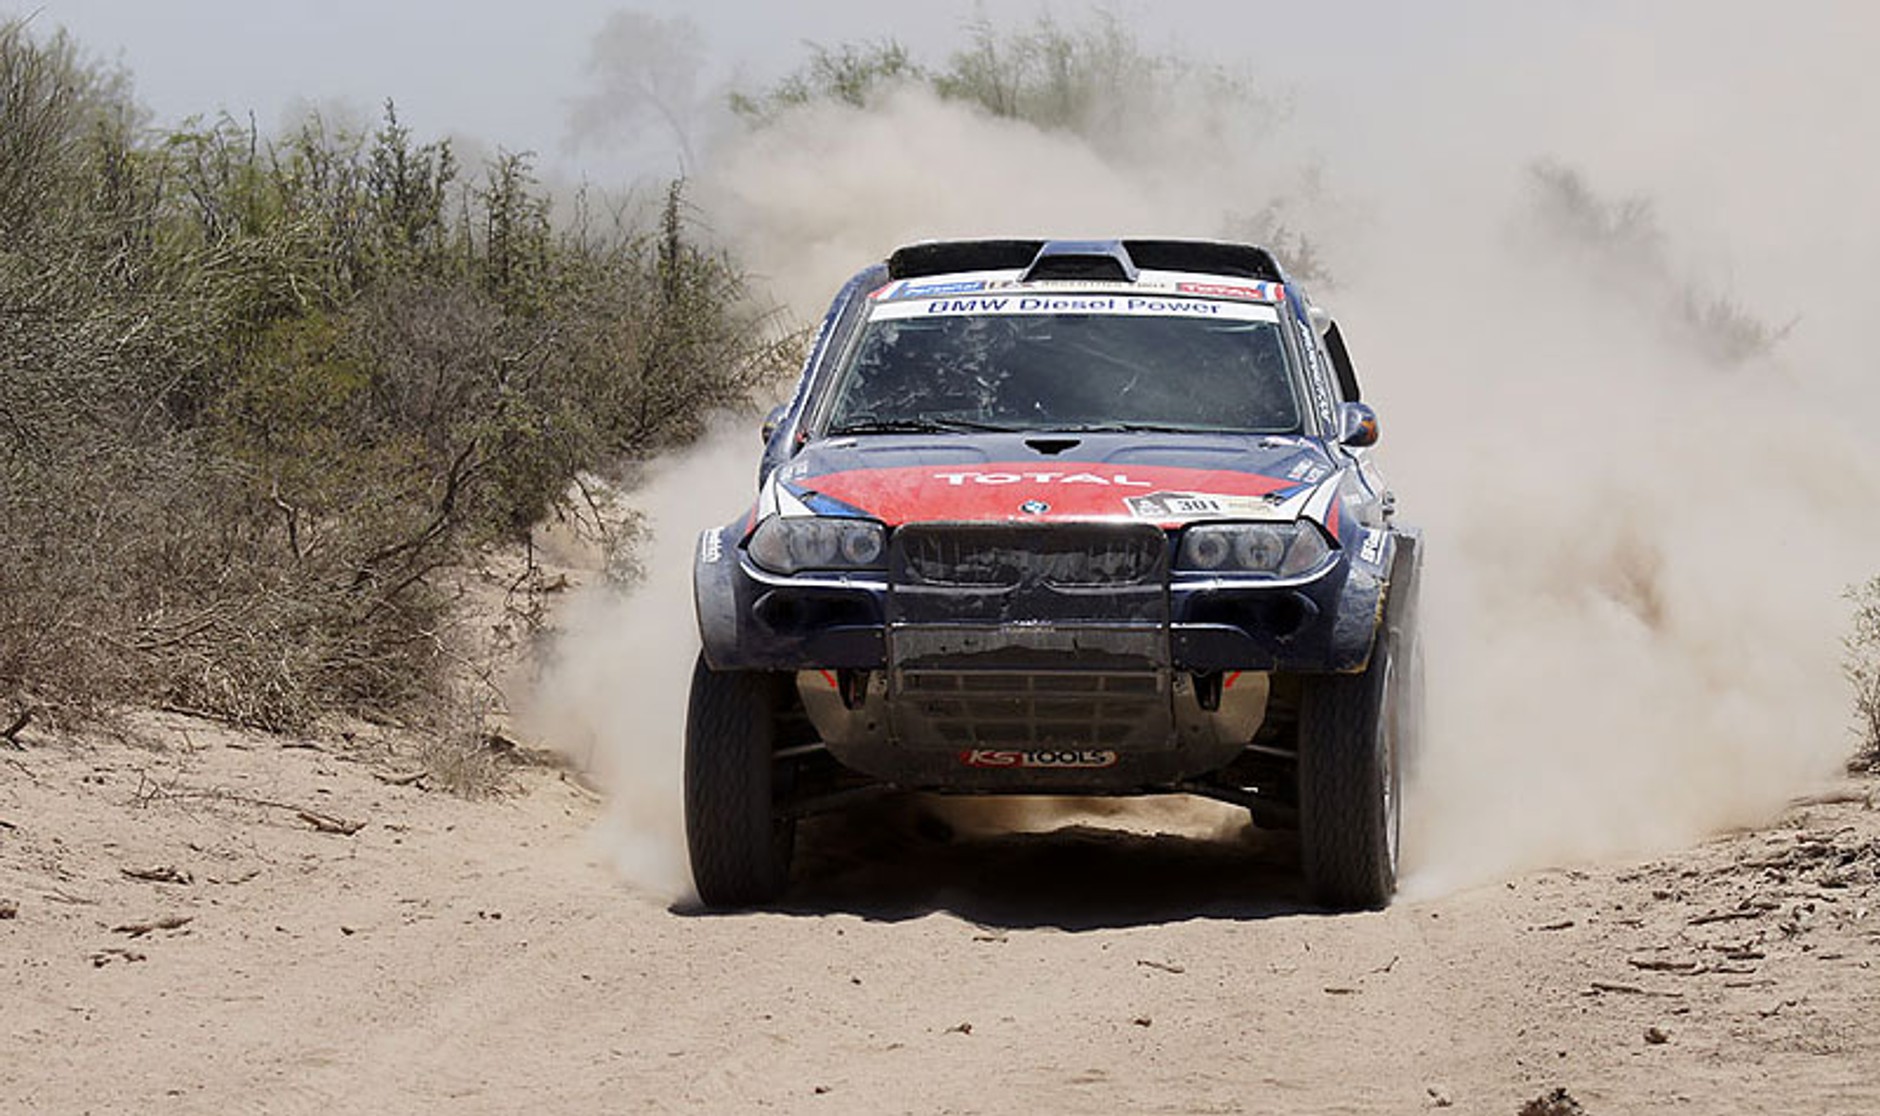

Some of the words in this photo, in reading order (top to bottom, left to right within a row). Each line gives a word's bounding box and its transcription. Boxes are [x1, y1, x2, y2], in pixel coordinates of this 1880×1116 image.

[928, 299, 1009, 314] BMW
[1020, 298, 1114, 311] Diesel
[1128, 299, 1220, 314] Power
[934, 472, 1152, 487] TOTAL
[1177, 500, 1221, 512] 301
[969, 750, 1016, 764] KS
[1026, 750, 1107, 764] TOOLS
